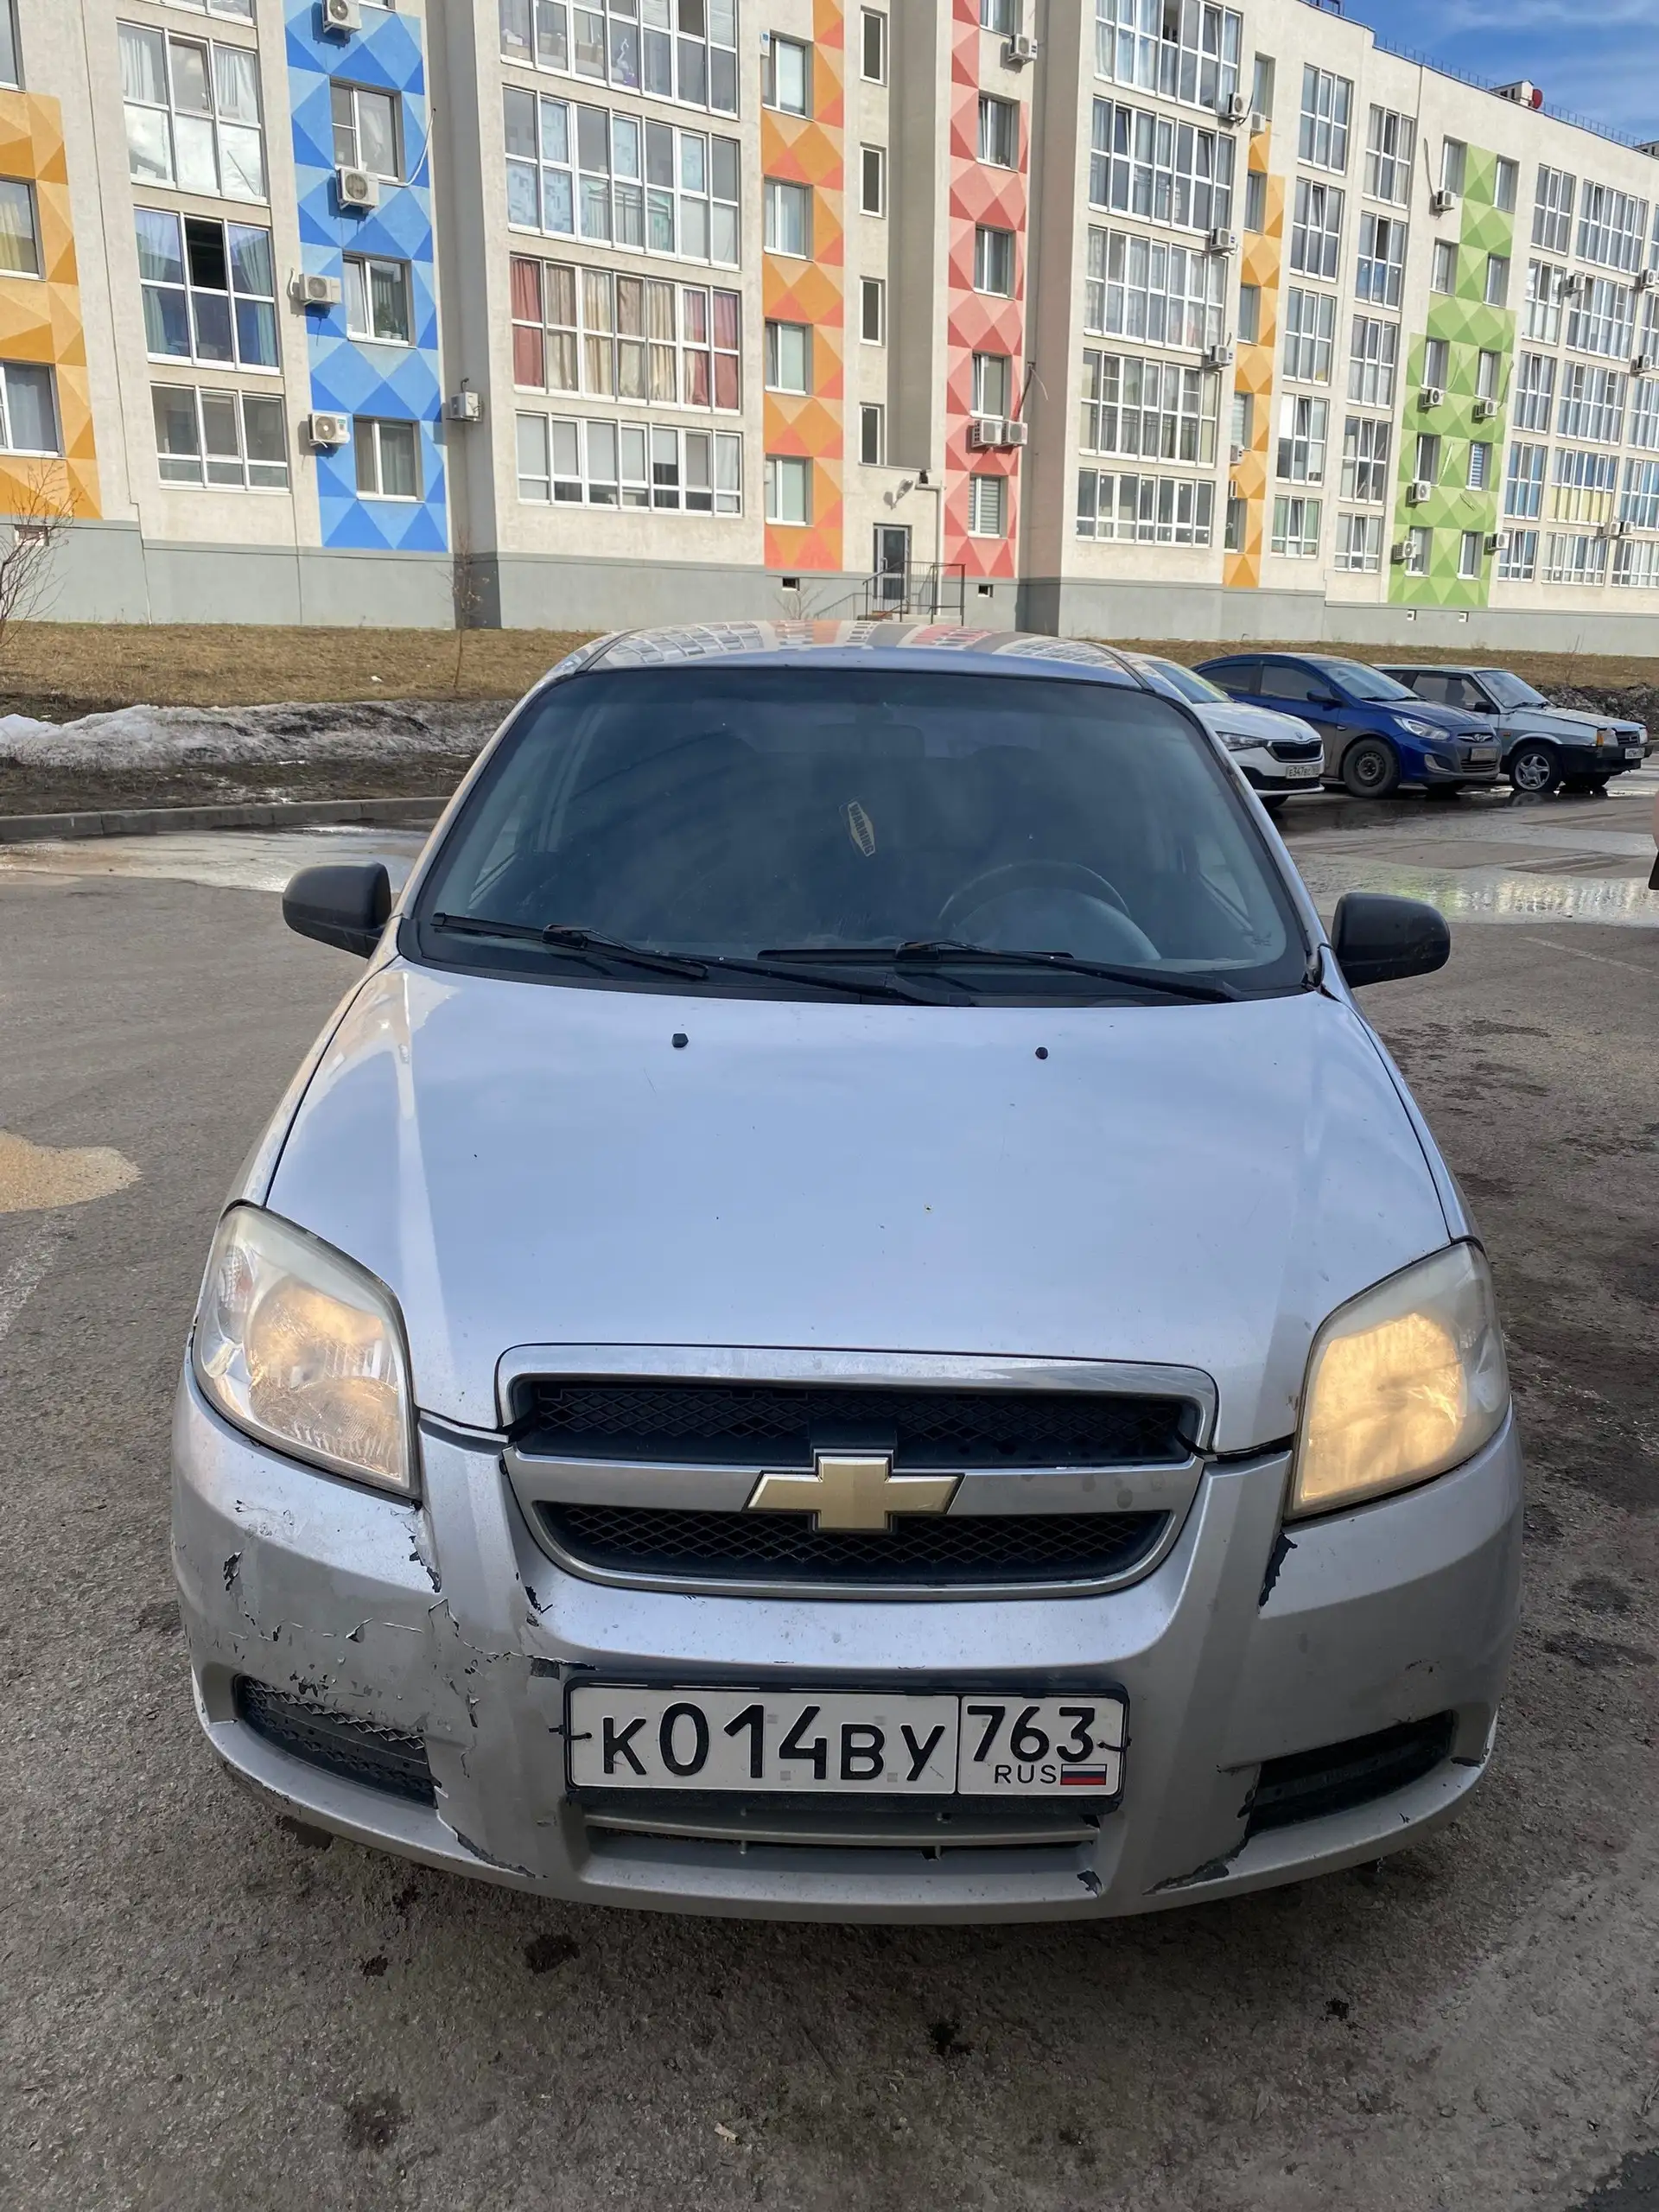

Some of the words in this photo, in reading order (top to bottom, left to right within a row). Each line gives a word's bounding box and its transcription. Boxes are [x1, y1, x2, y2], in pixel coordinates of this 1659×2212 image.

[602, 1702, 946, 1782] К014ВУ
[966, 1705, 1096, 1764] 763
[994, 1764, 1058, 1784] RUS
